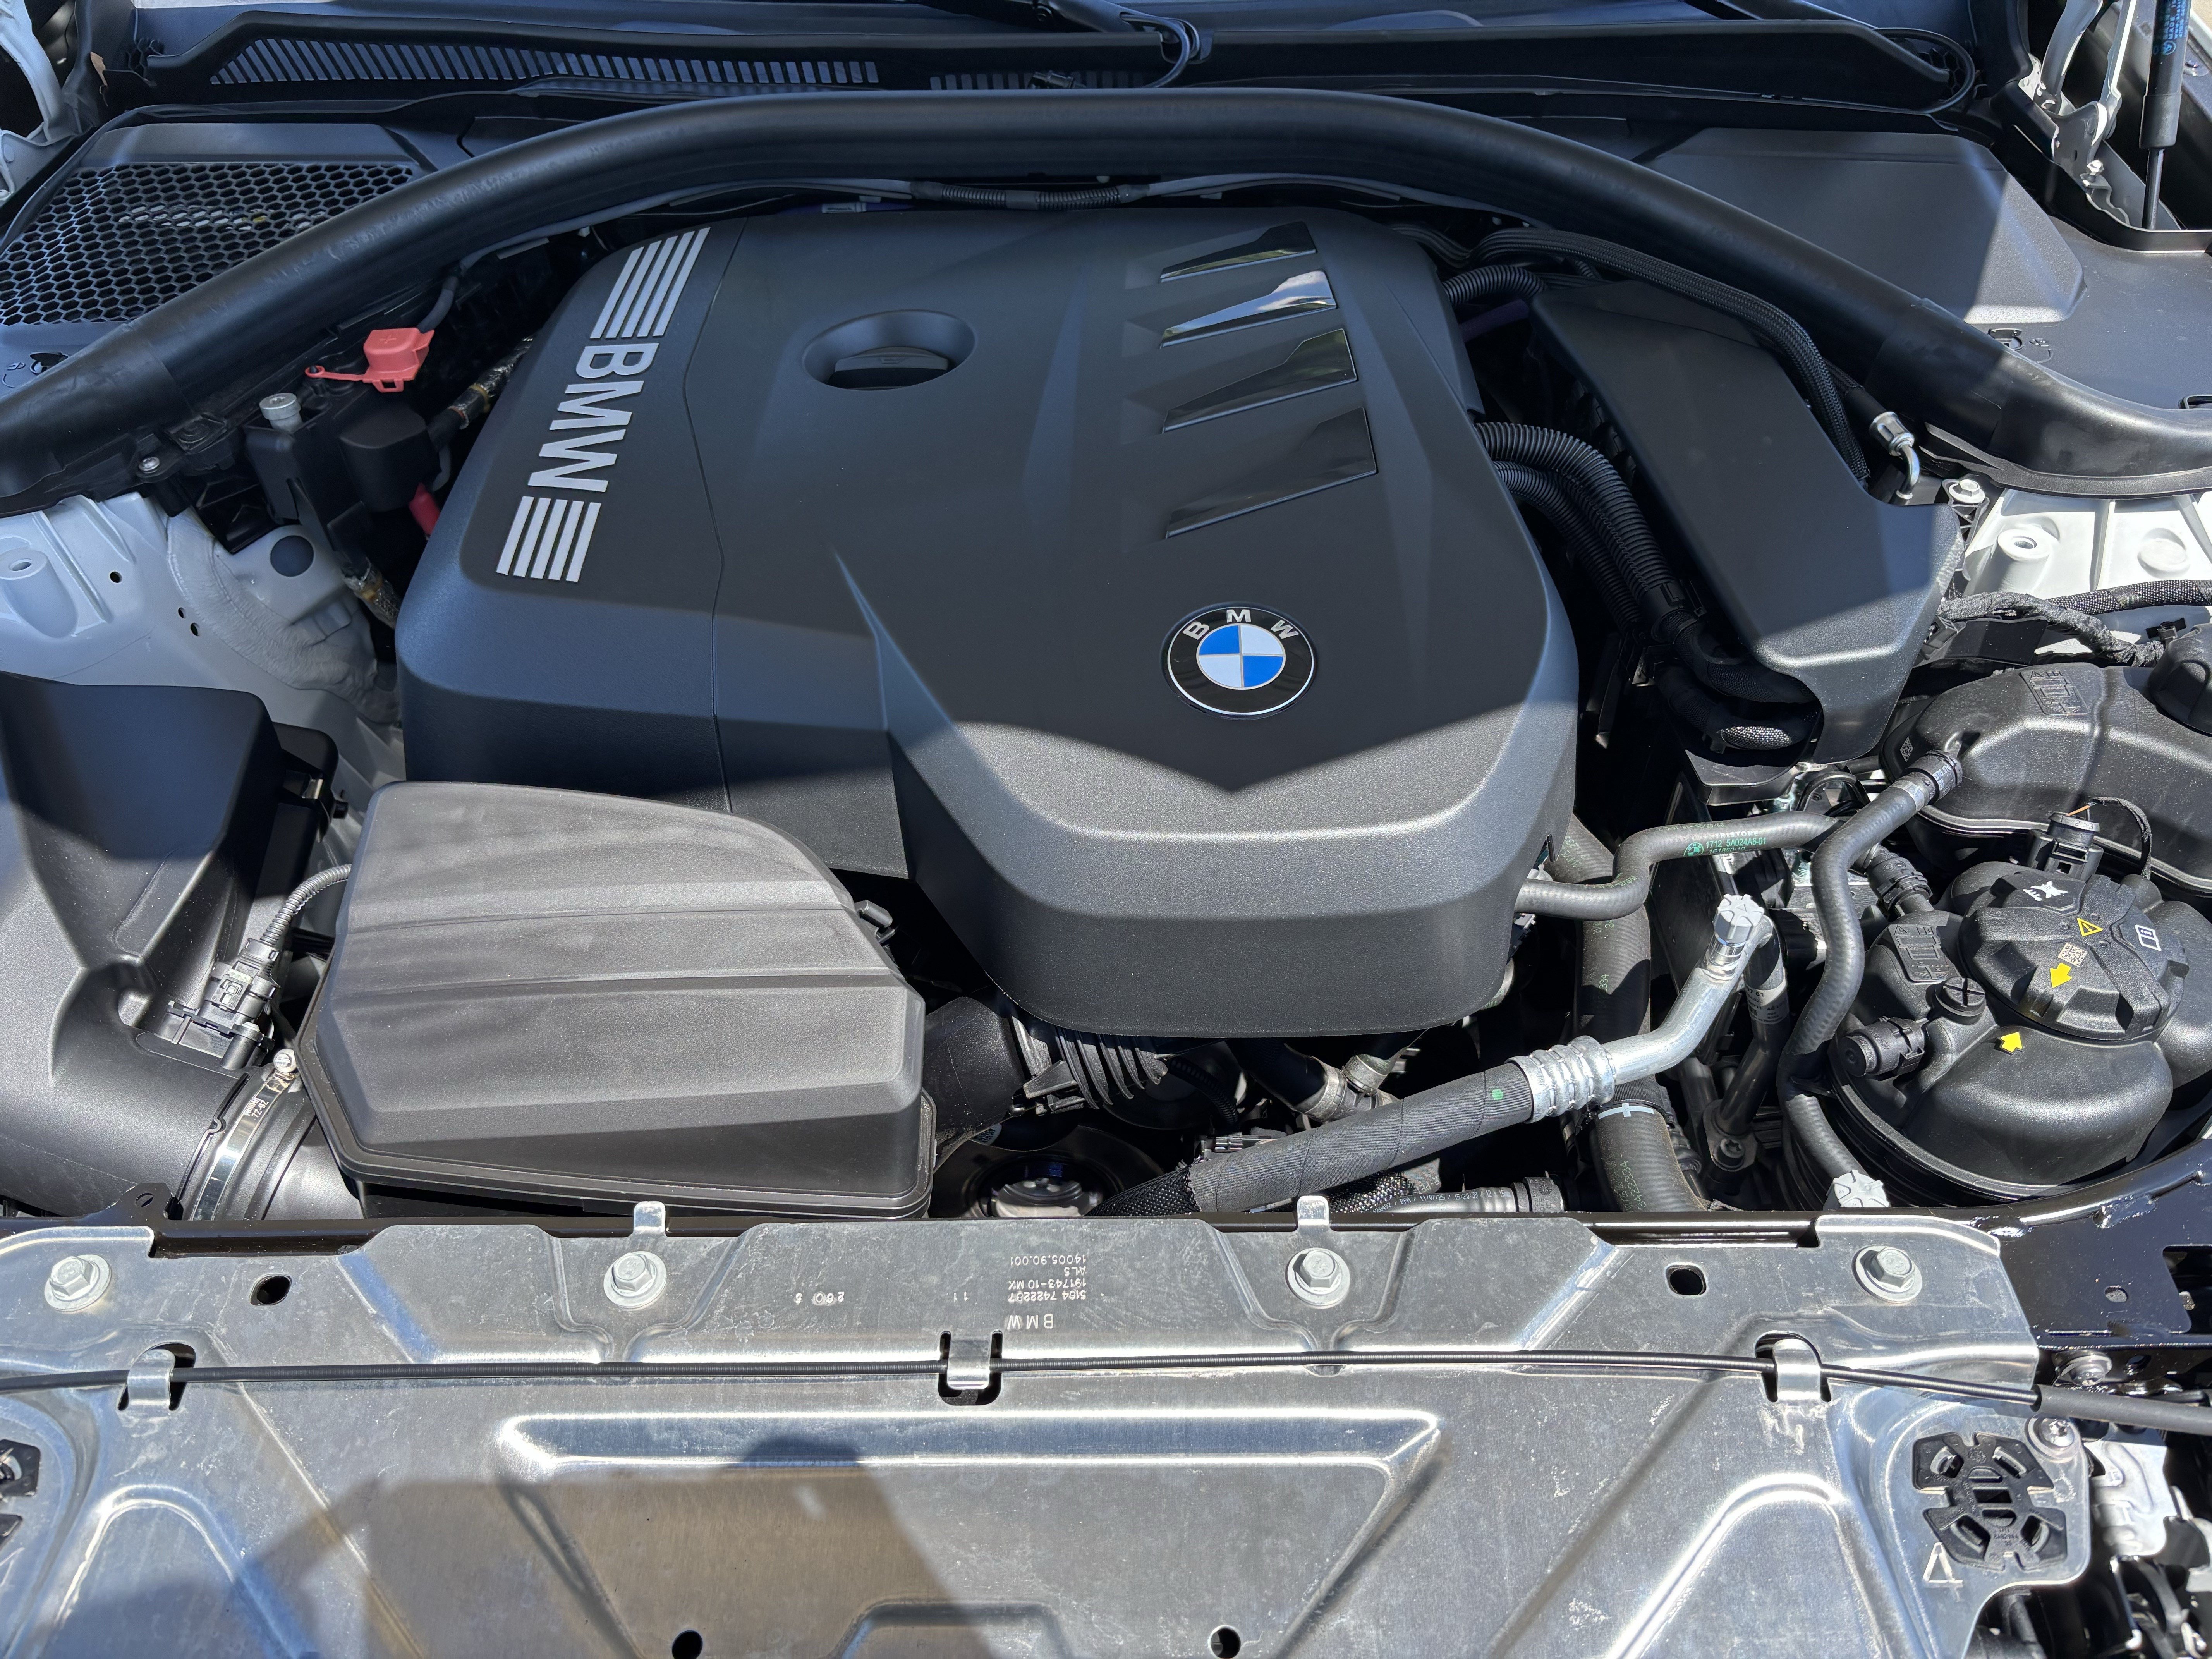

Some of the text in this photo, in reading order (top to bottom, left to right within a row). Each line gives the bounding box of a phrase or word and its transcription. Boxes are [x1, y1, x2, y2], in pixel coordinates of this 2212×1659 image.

[527, 343, 659, 492] BMW
[1182, 609, 1299, 640] BMW
[1706, 837, 1766, 849] 1712 5A024A6-01
[1010, 1253, 1086, 1266] 14005.90.001
[1008, 1278, 1087, 1290] 191743-10 MX
[1008, 1290, 1086, 1303] 5164 7422287
[1007, 1313, 1054, 1329] BMW
